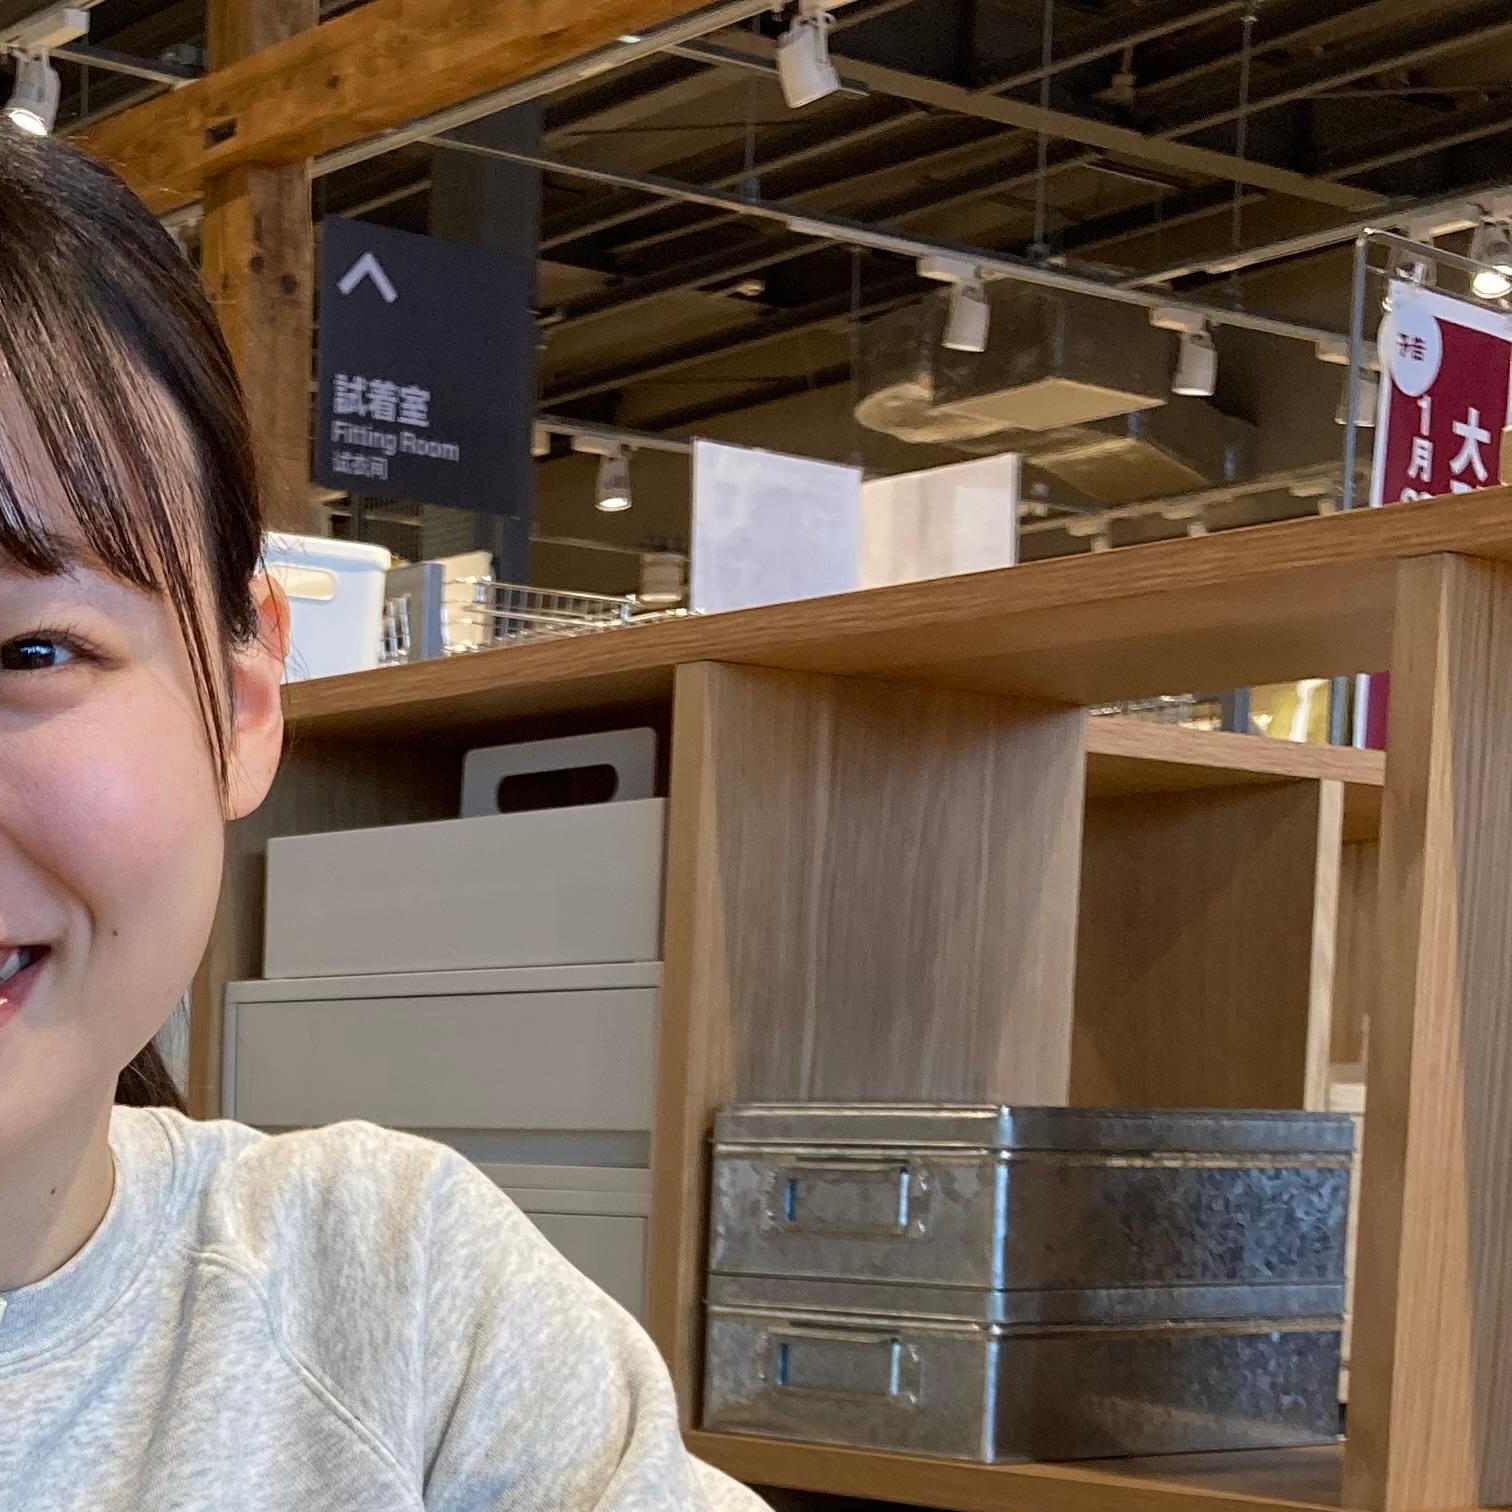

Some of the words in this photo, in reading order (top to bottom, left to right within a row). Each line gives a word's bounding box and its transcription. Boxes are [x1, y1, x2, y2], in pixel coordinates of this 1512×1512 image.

[332, 373, 431, 428] 試着室
[331, 420, 397, 456] Fitting
[399, 431, 460, 462] Room
